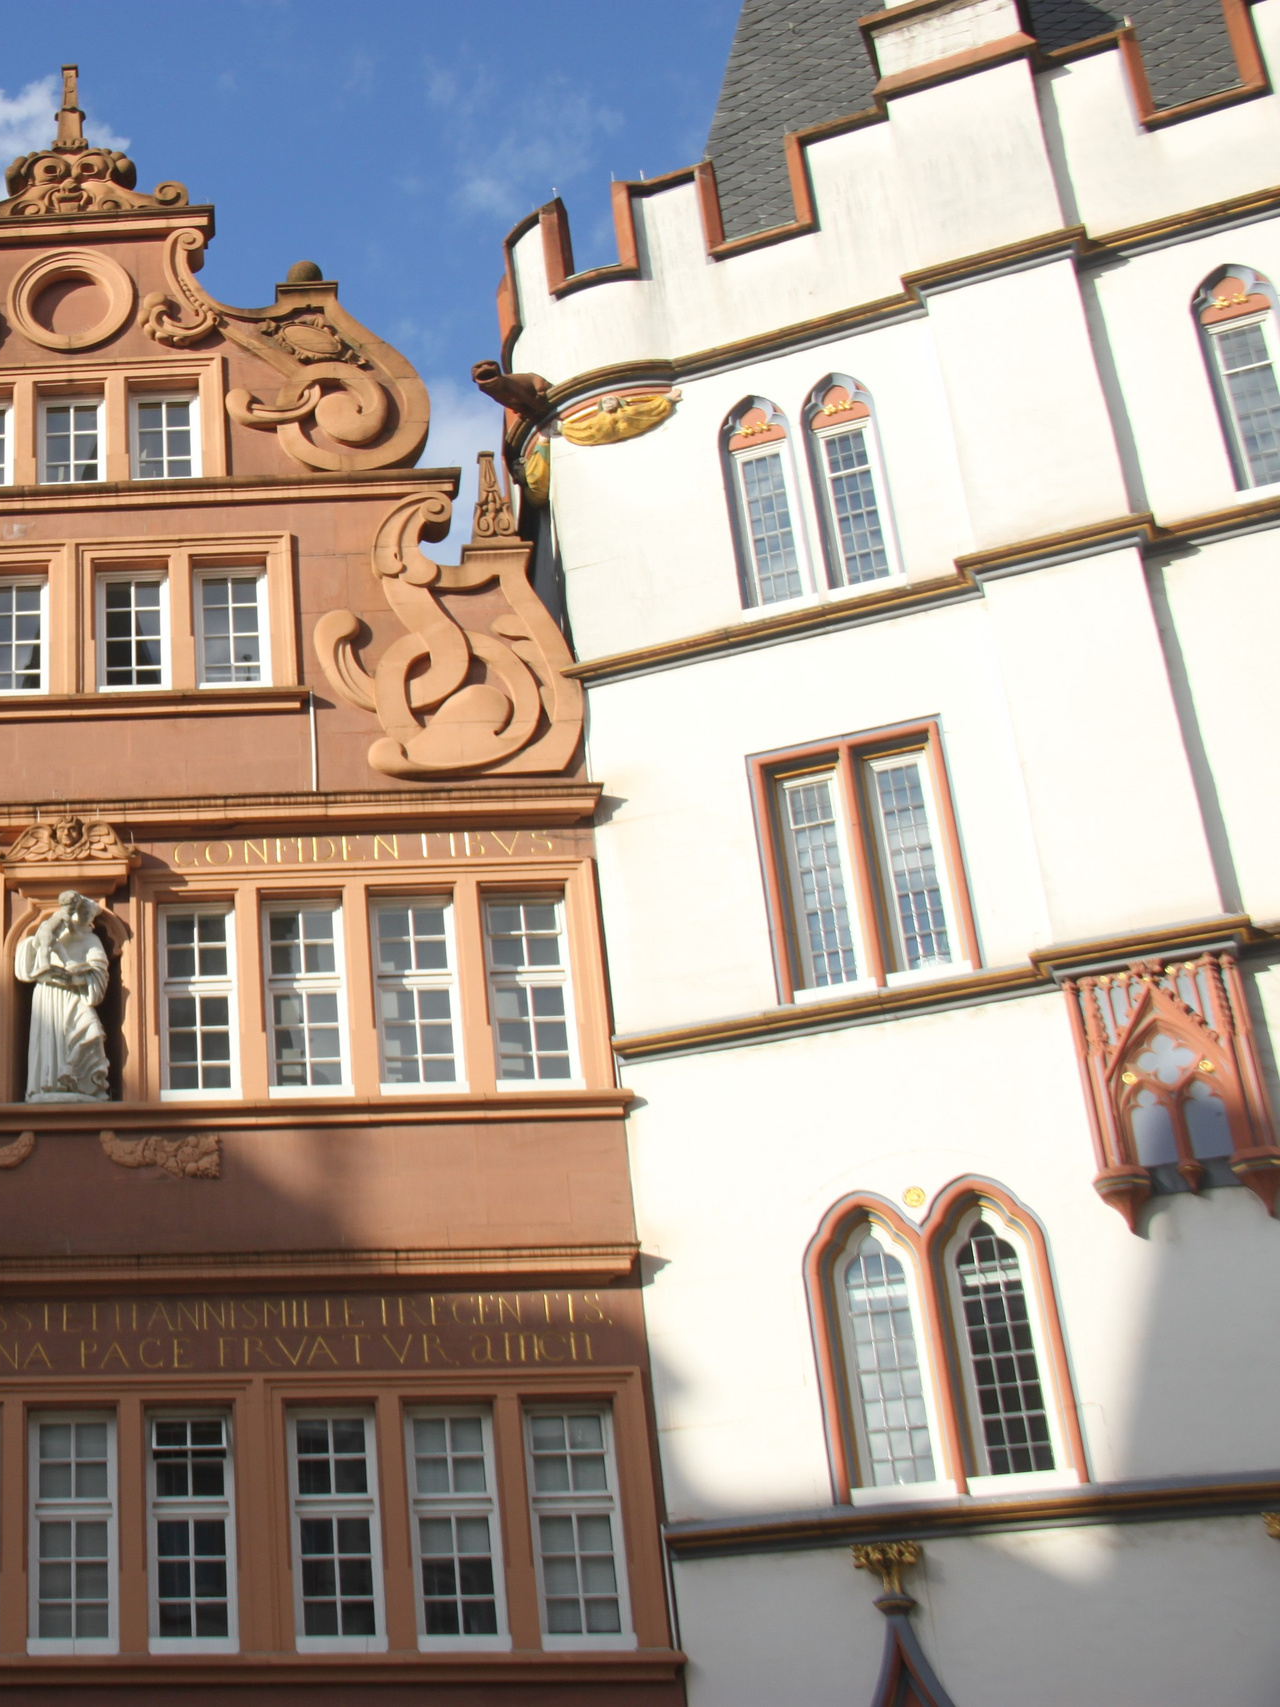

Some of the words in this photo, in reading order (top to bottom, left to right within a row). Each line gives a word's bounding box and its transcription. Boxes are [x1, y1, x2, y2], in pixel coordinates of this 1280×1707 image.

[173, 831, 553, 867] CONFIDENTIBVS
[15, 1301, 147, 1333] STETIT
[147, 1301, 258, 1331] ANNIS
[263, 1298, 365, 1329] MILLE
[79, 1337, 194, 1369] PACE
[469, 1330, 594, 1365] amen
